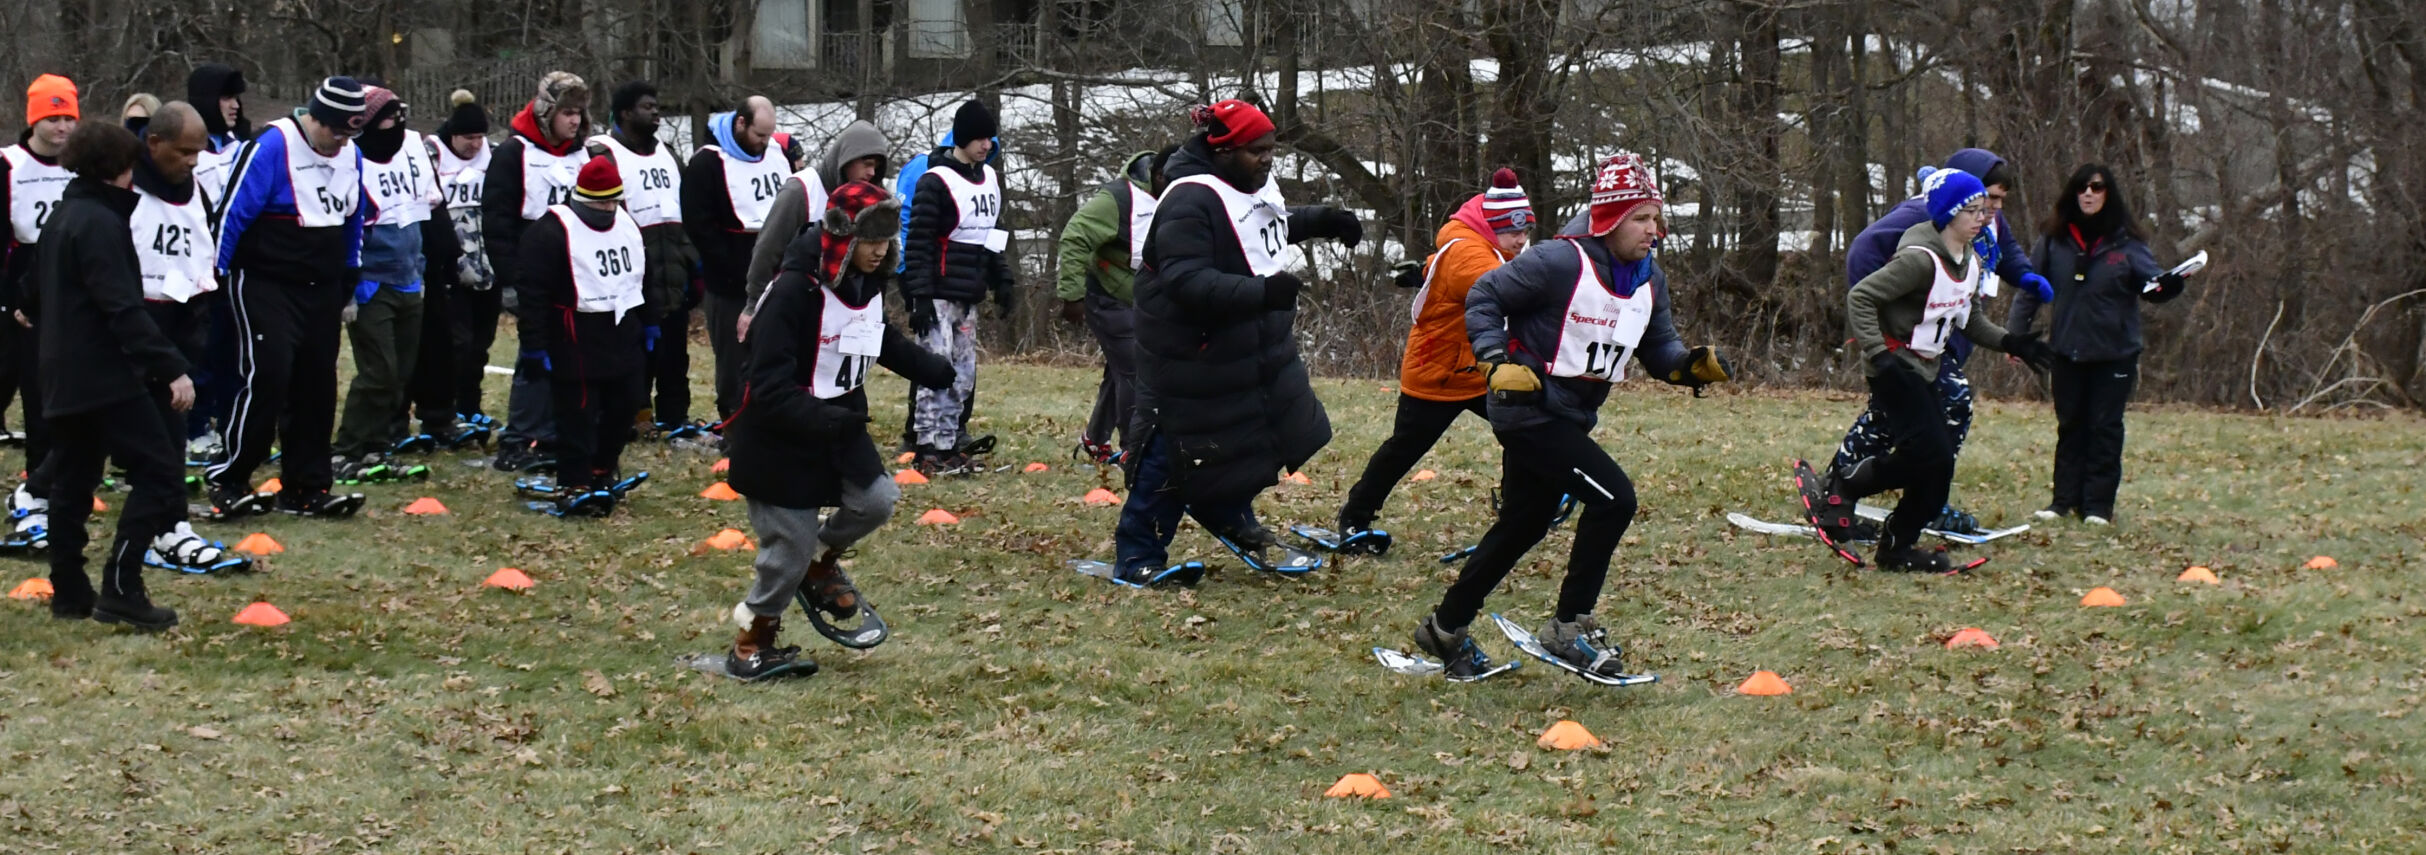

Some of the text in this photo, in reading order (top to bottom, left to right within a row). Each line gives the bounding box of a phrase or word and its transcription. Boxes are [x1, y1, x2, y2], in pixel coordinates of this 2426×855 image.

[639, 167, 671, 191] 286
[750, 171, 782, 202] 248
[448, 182, 482, 205] 784
[970, 193, 996, 217] 146
[152, 223, 192, 258] 425
[595, 245, 632, 278] 360
[1570, 311, 1608, 327] Special
